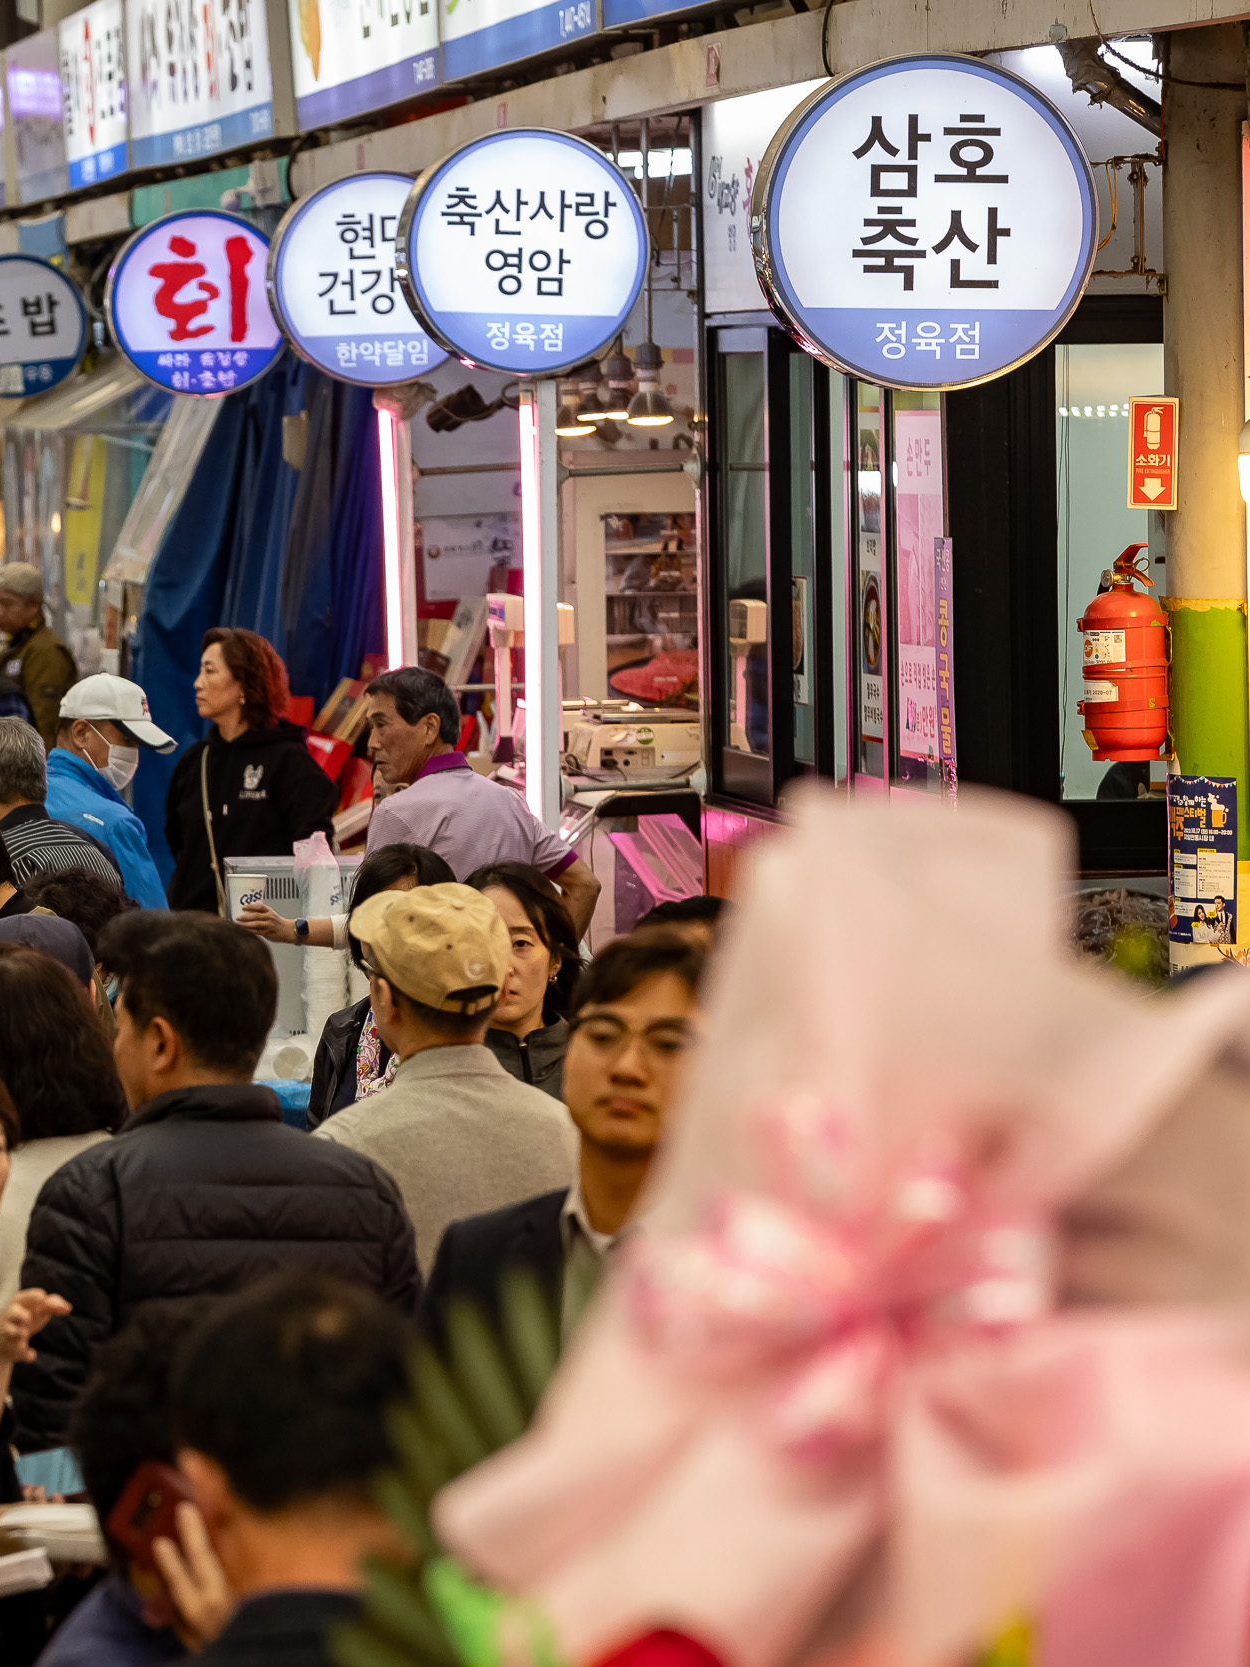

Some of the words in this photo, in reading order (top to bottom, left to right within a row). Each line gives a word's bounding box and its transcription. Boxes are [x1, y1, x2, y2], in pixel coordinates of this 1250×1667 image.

[852, 113, 1009, 198] 삼호
[440, 187, 617, 240] 축산사랑
[485, 247, 571, 297] 영암
[852, 206, 1011, 291] 축산
[149, 235, 254, 342] 회
[334, 340, 430, 369] 한약달임
[486, 322, 565, 352] 정육점
[875, 321, 981, 360] 정육점
[1135, 453, 1170, 467] 소화기
